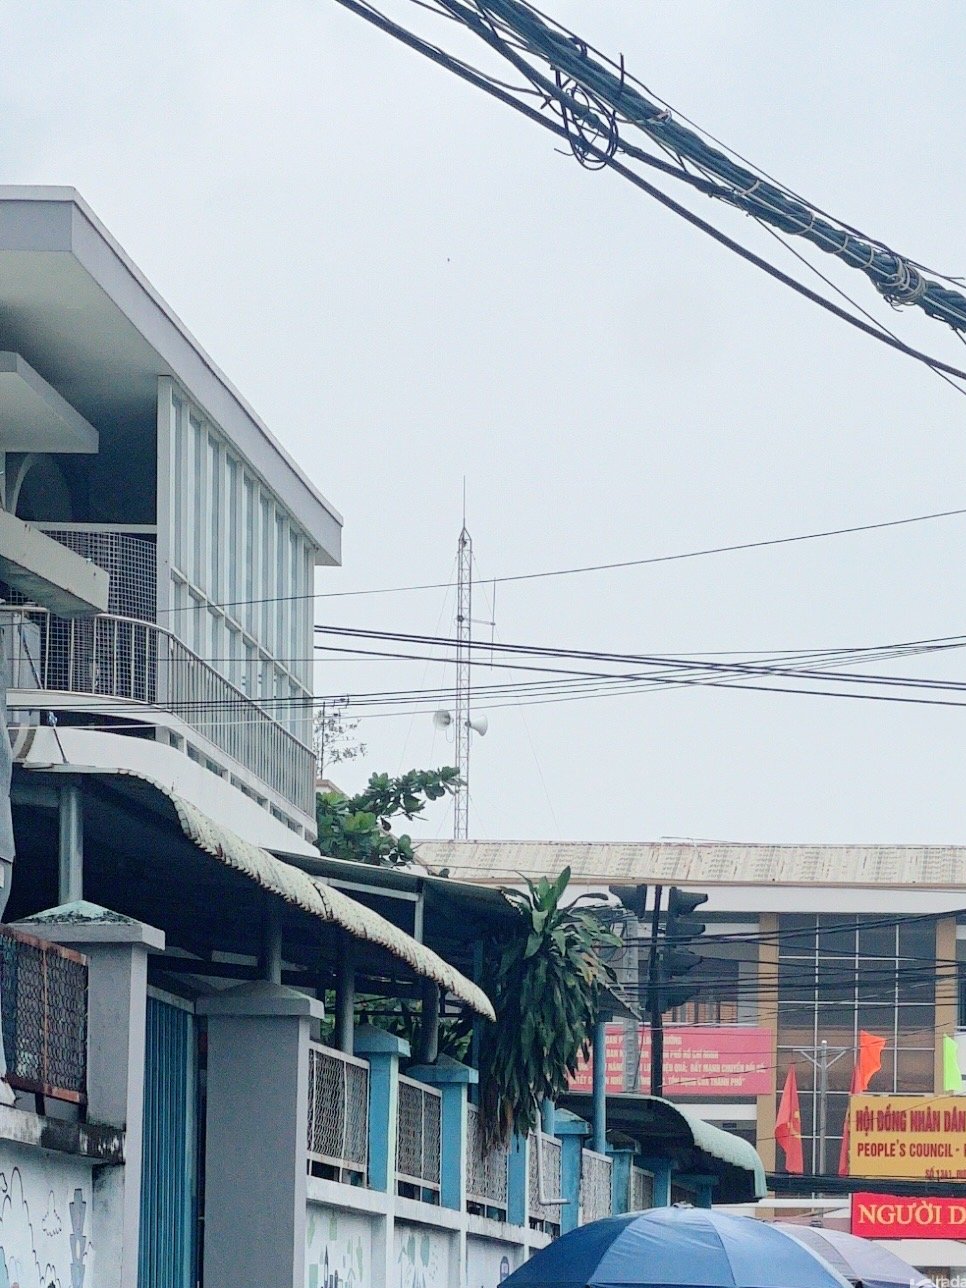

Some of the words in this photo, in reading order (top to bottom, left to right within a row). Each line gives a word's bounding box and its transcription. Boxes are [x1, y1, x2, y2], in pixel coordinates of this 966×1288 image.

[856, 1105, 873, 1137] HỘI
[910, 1106, 941, 1132] NHÂN
[944, 1106, 966, 1132] DÂN
[909, 1143, 954, 1157] COUNCIL
[858, 1201, 942, 1225] NGƯỜI
